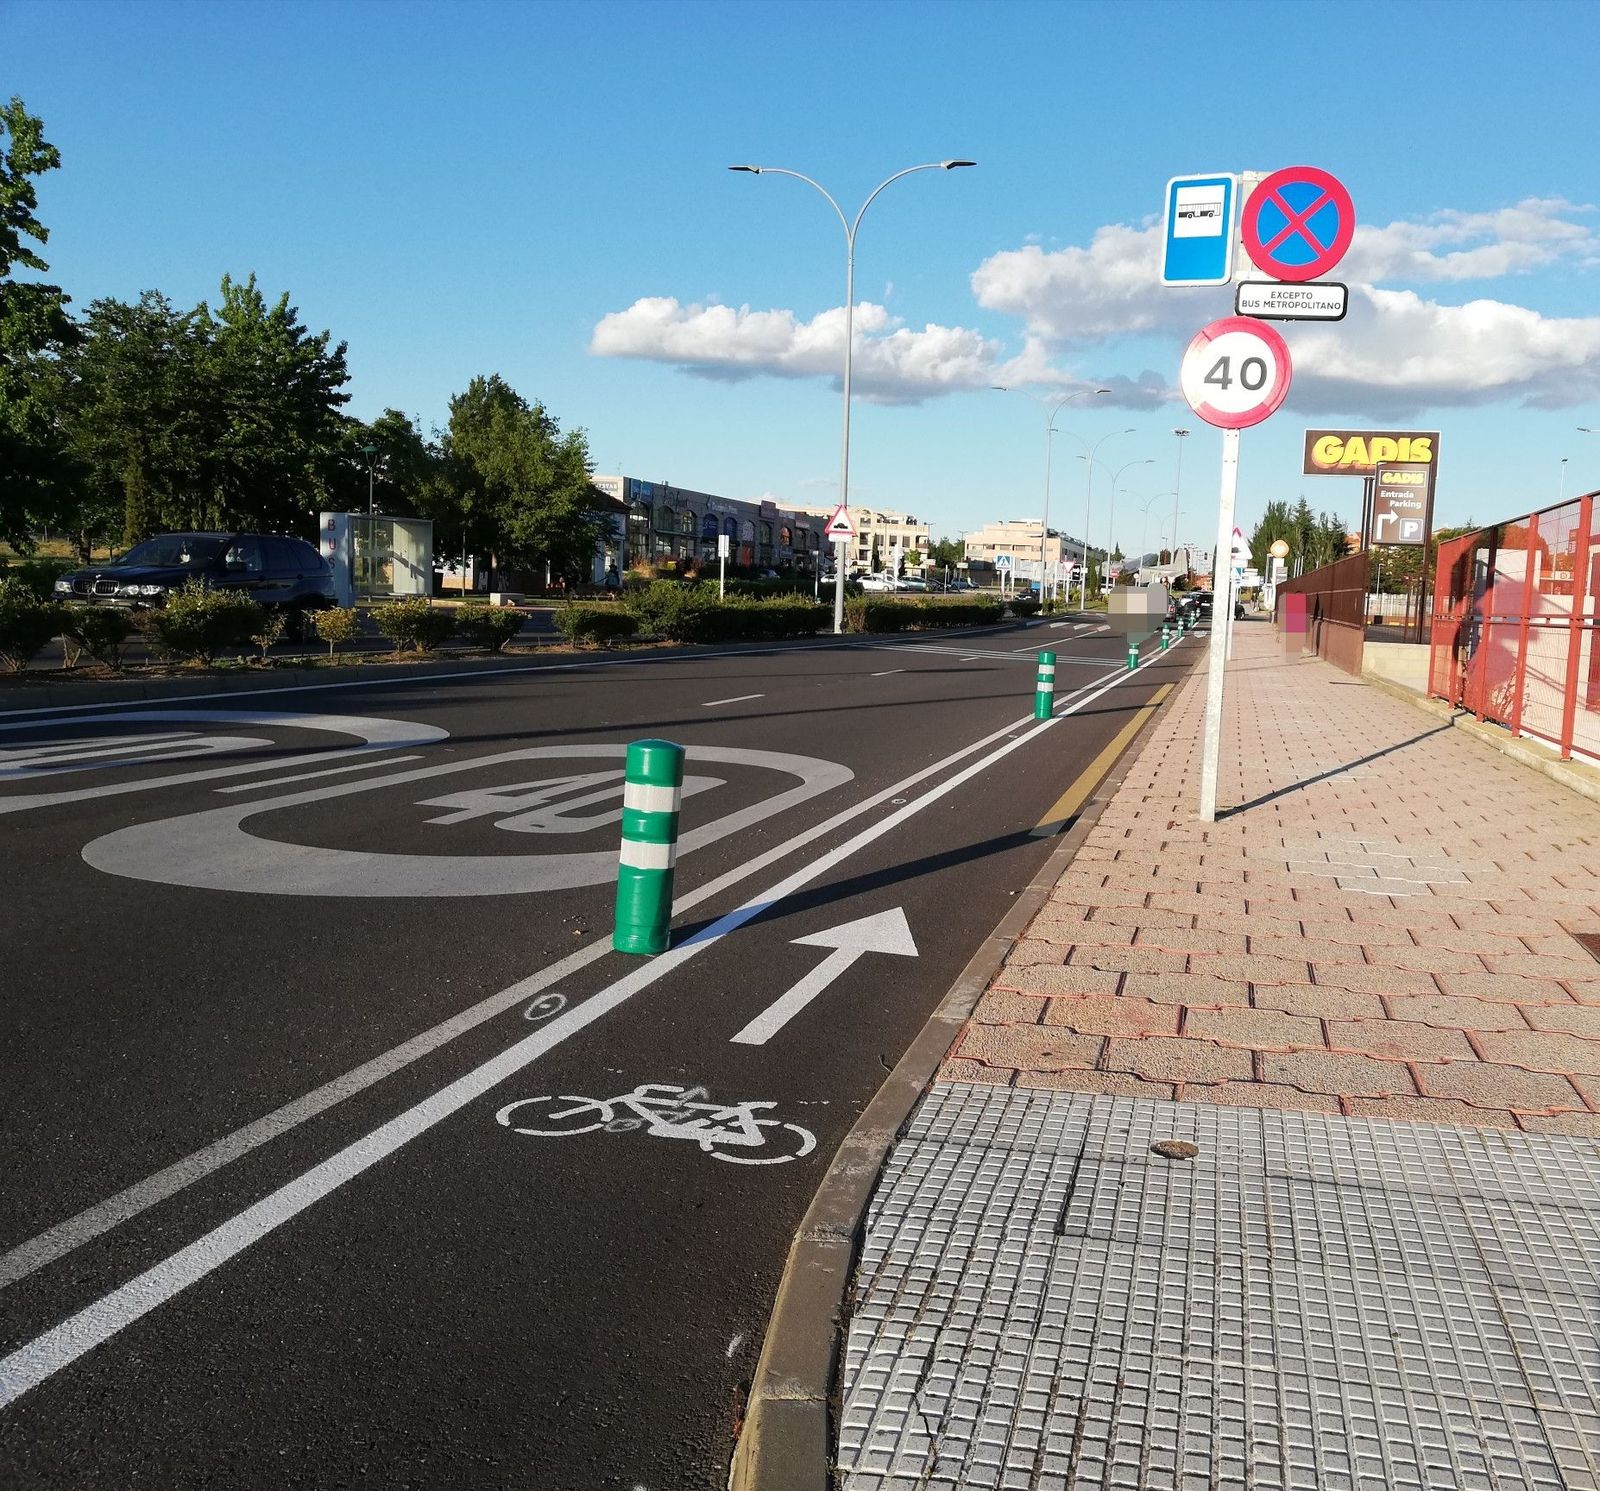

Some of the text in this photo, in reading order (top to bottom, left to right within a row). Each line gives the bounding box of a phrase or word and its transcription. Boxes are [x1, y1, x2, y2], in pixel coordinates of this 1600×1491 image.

[1270, 291, 1313, 300] EXCEPTO
[1241, 299, 1341, 310] BUS METROPOLITANO
[1203, 355, 1268, 391] 40
[1311, 435, 1433, 467] GADIS
[1381, 472, 1425, 485] GADIS
[1380, 490, 1414, 499] Entrada
[1389, 500, 1422, 510] Parking
[1403, 521, 1419, 538] P
[327, 519, 336, 569] BUS
[413, 769, 728, 834] 40
